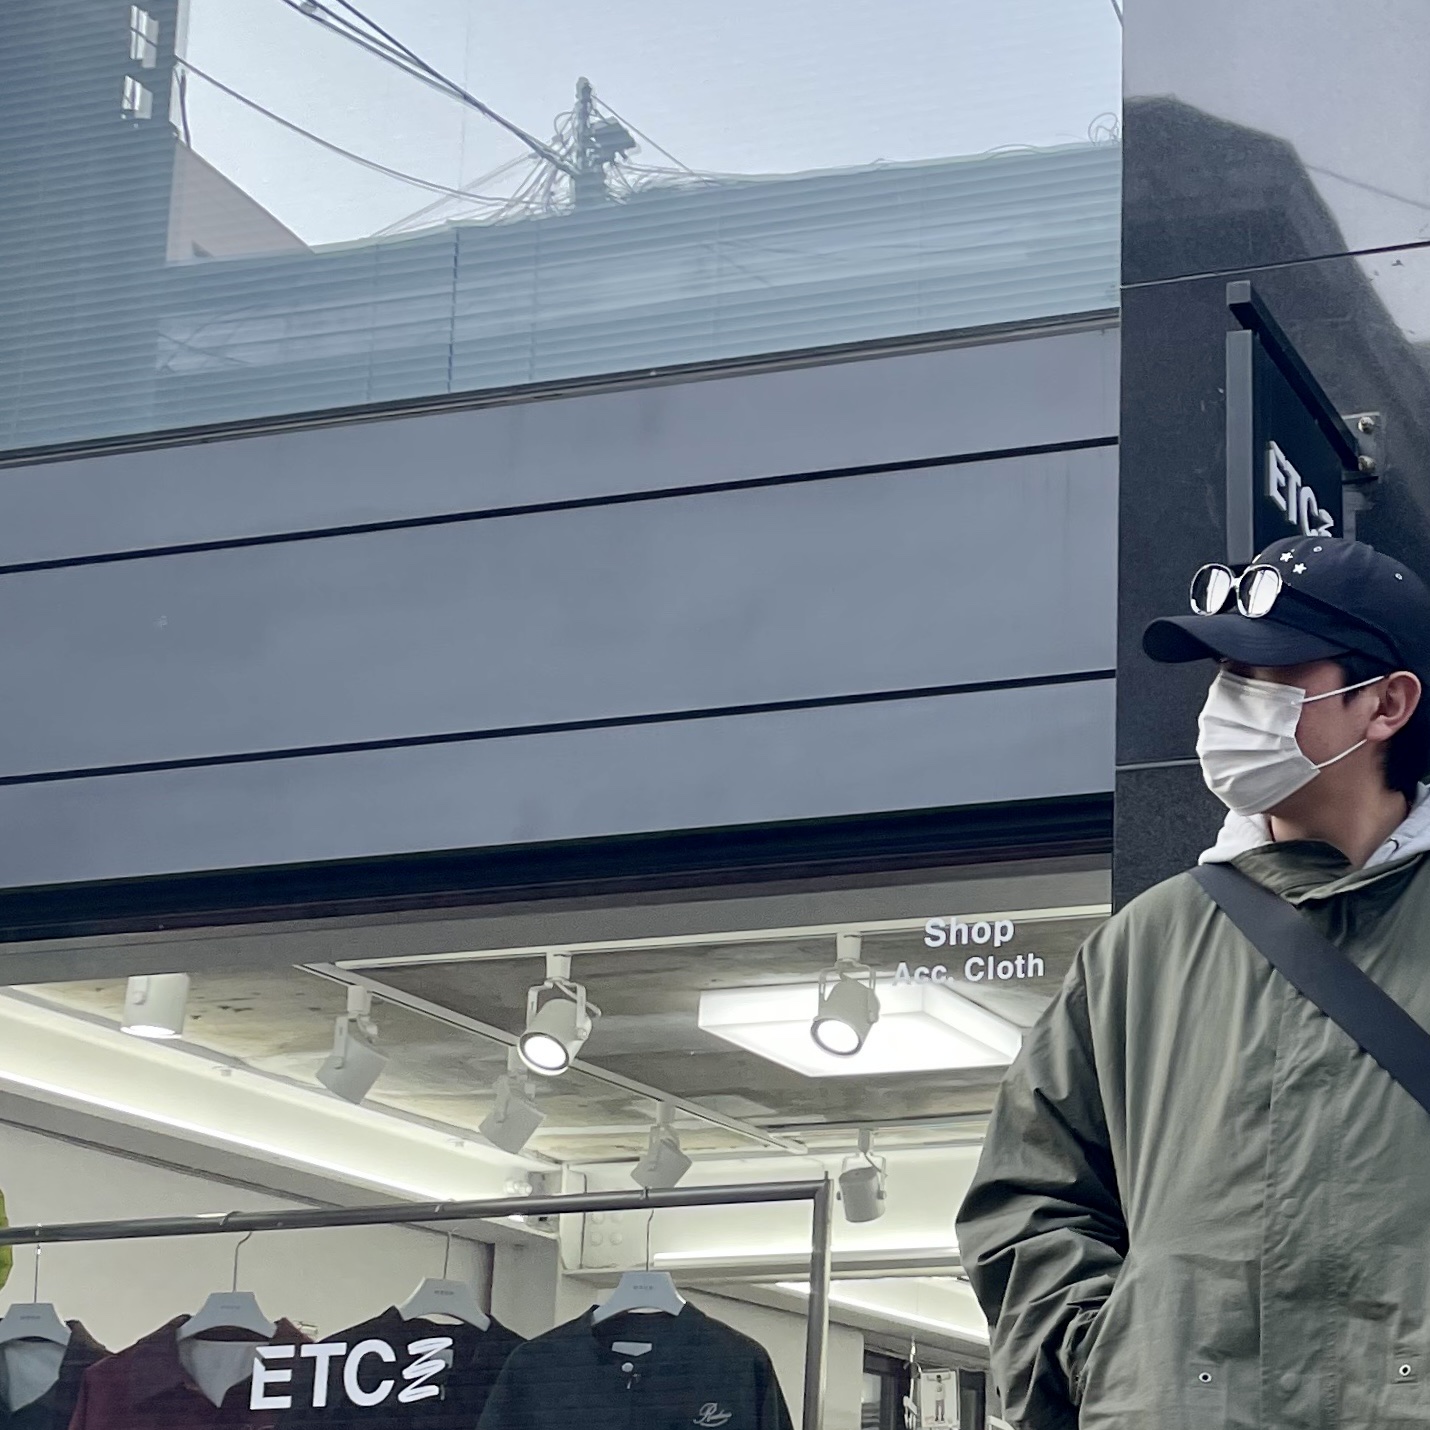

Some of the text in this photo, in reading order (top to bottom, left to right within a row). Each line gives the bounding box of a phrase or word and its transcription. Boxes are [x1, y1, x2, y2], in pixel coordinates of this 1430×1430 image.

[924, 917, 1015, 948] Shop
[892, 952, 1045, 986] Acc. Cloth
